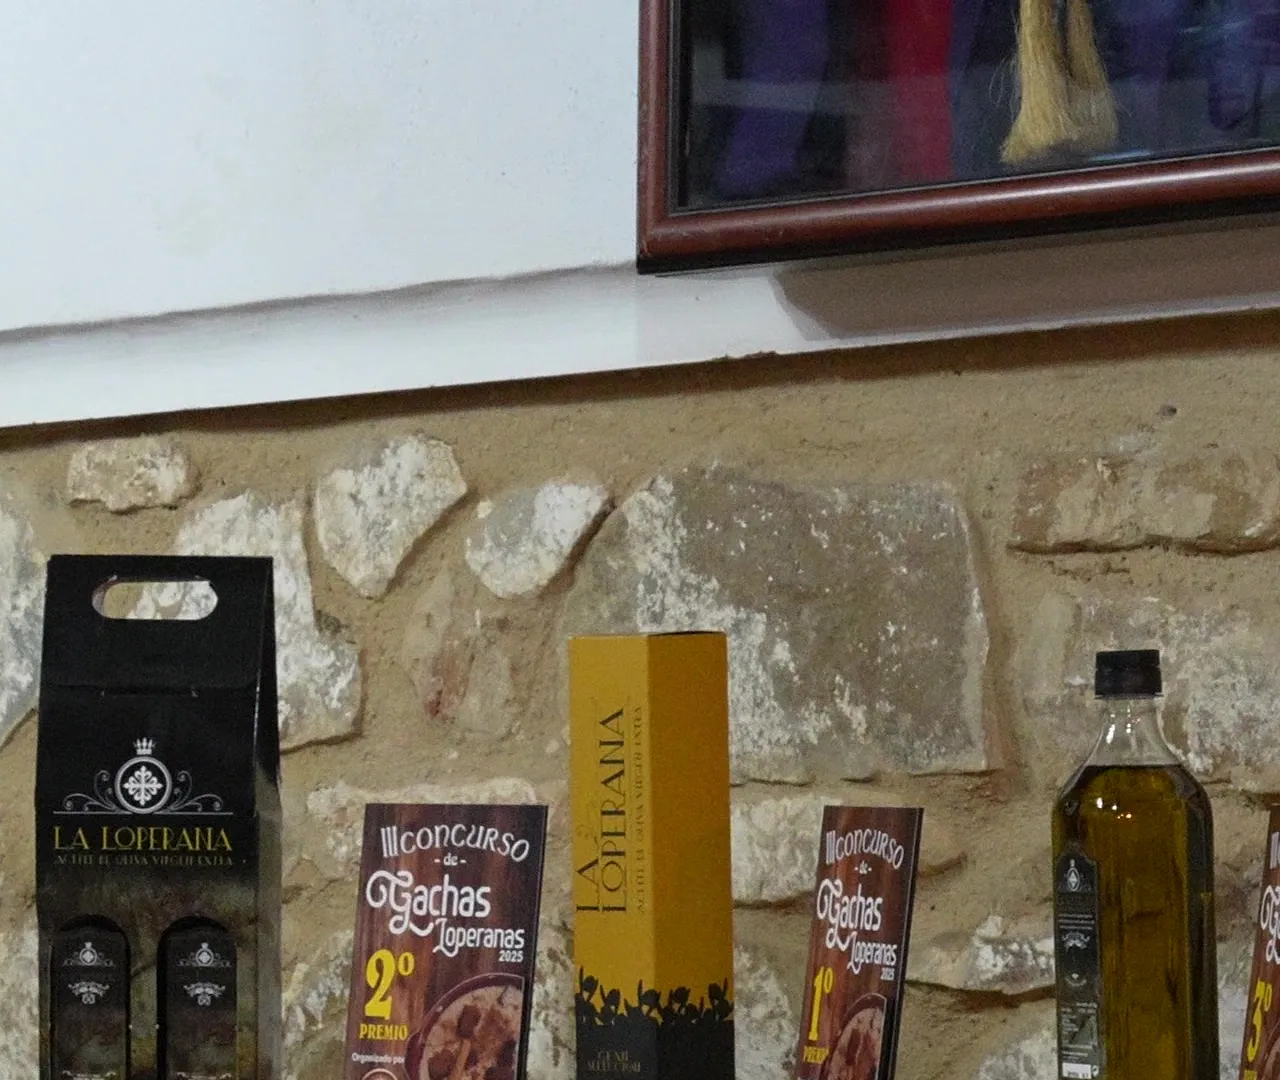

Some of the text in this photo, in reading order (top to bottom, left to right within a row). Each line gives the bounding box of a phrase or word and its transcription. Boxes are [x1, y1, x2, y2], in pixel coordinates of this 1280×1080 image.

[599, 708, 626, 912] LOPERANA
[54, 826, 232, 851] LA LOPERANA
[366, 870, 491, 937] Gachas
[576, 858, 599, 911] LA
[433, 918, 525, 957] Loperanas
[817, 878, 883, 951] Gachas
[498, 949, 523, 963] 2025
[847, 931, 898, 975] Loperanas
[365, 948, 416, 1021] 2º
[359, 1023, 409, 1041] PREMIO
